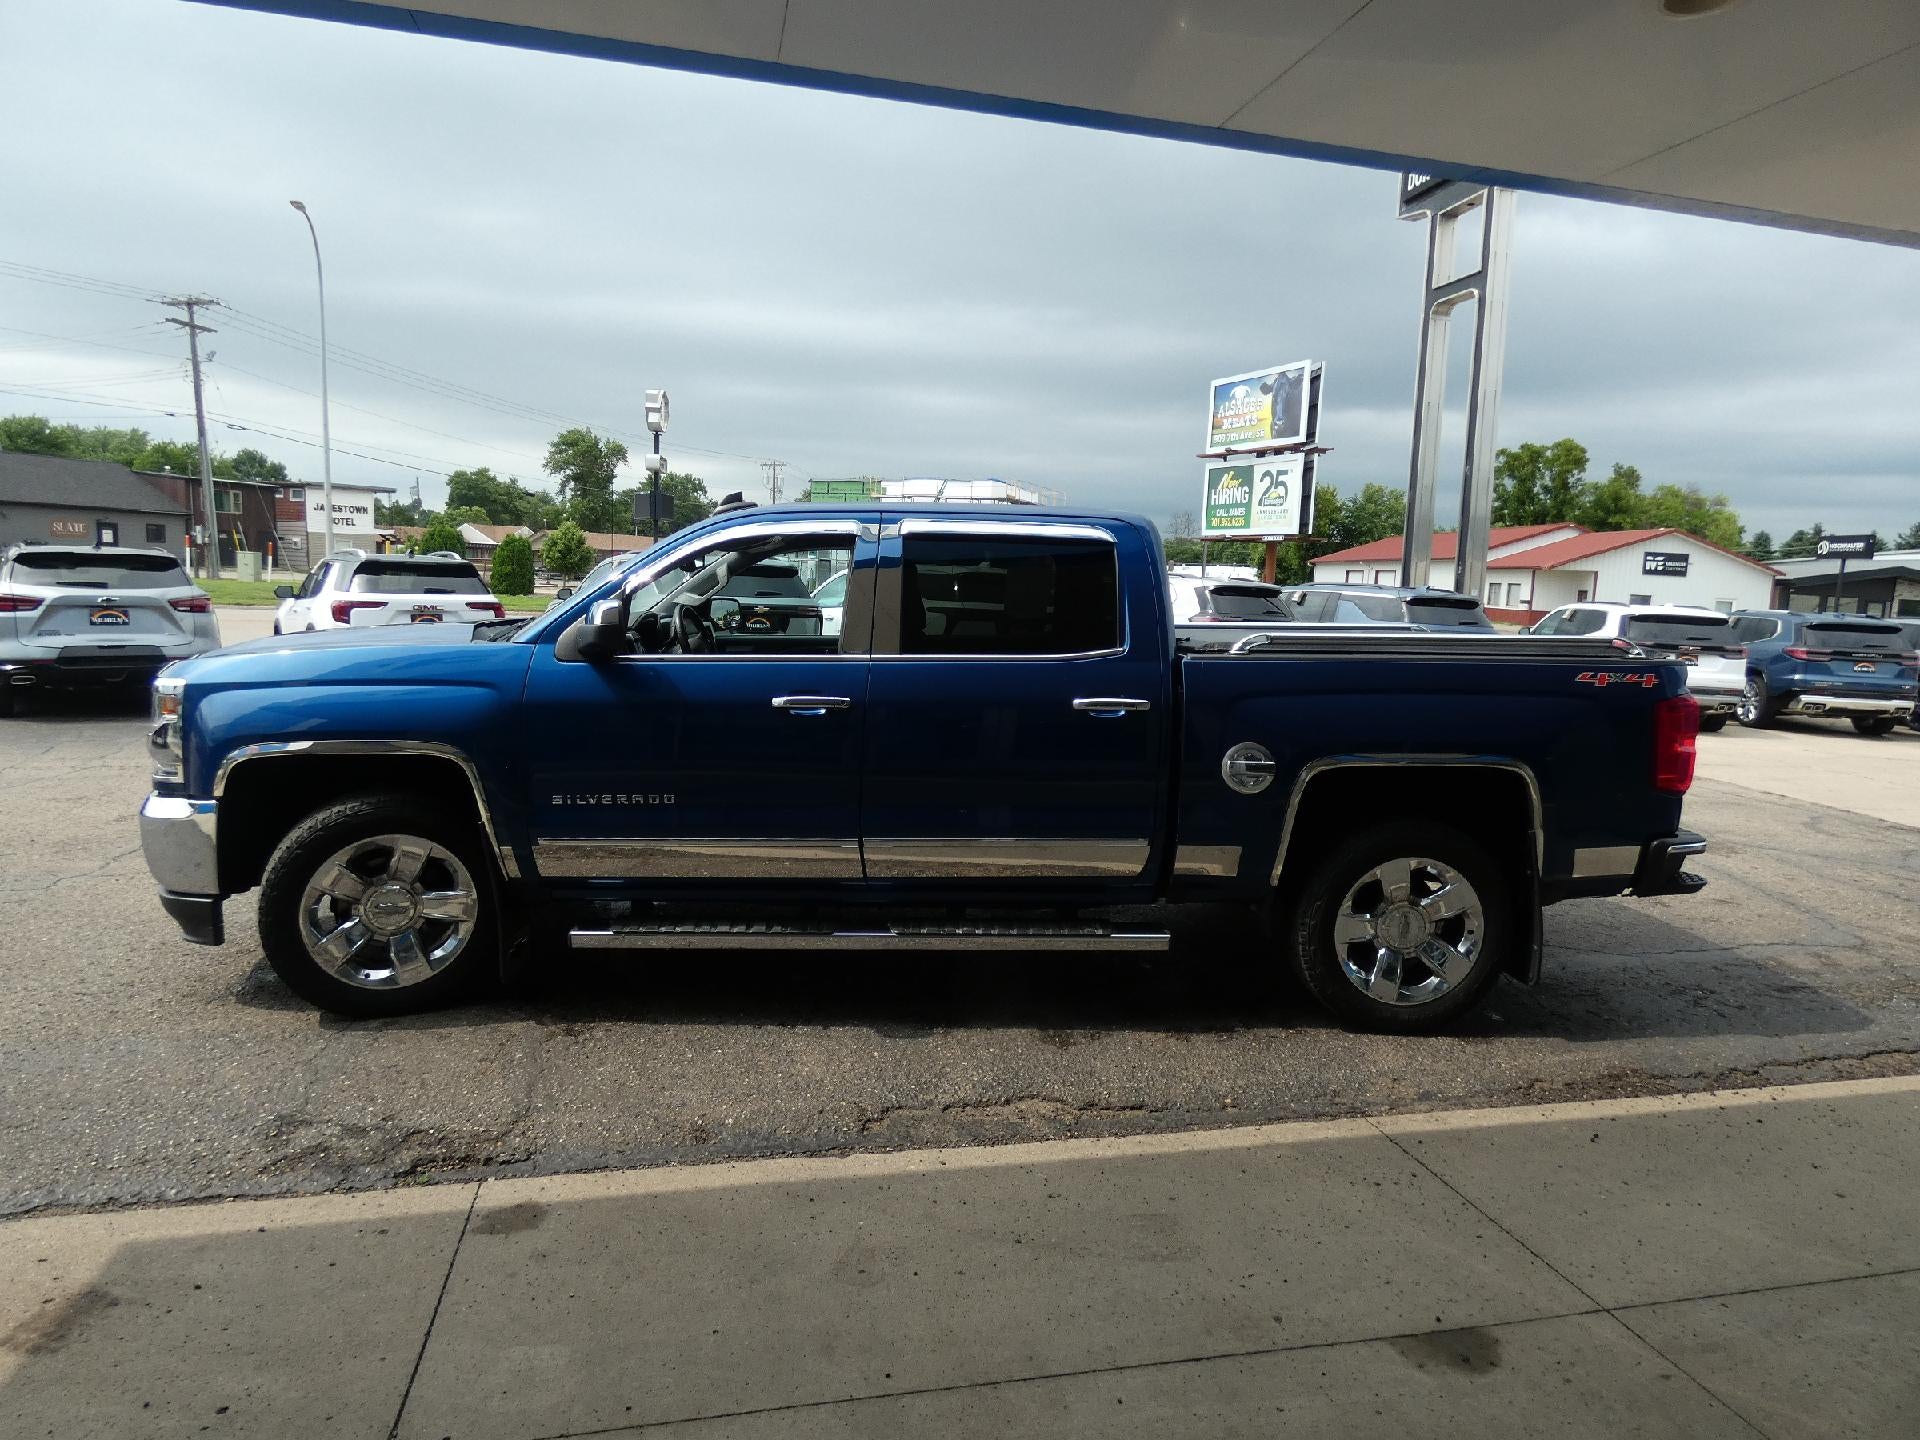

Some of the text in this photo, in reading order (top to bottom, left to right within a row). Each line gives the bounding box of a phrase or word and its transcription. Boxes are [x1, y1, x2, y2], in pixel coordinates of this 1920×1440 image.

[1211, 486, 1250, 505] HIRING
[313, 503, 369, 515] JAESTOWN
[53, 521, 87, 533] SLATE
[332, 517, 356, 527] OTEL
[551, 794, 676, 805] SILVERADO
